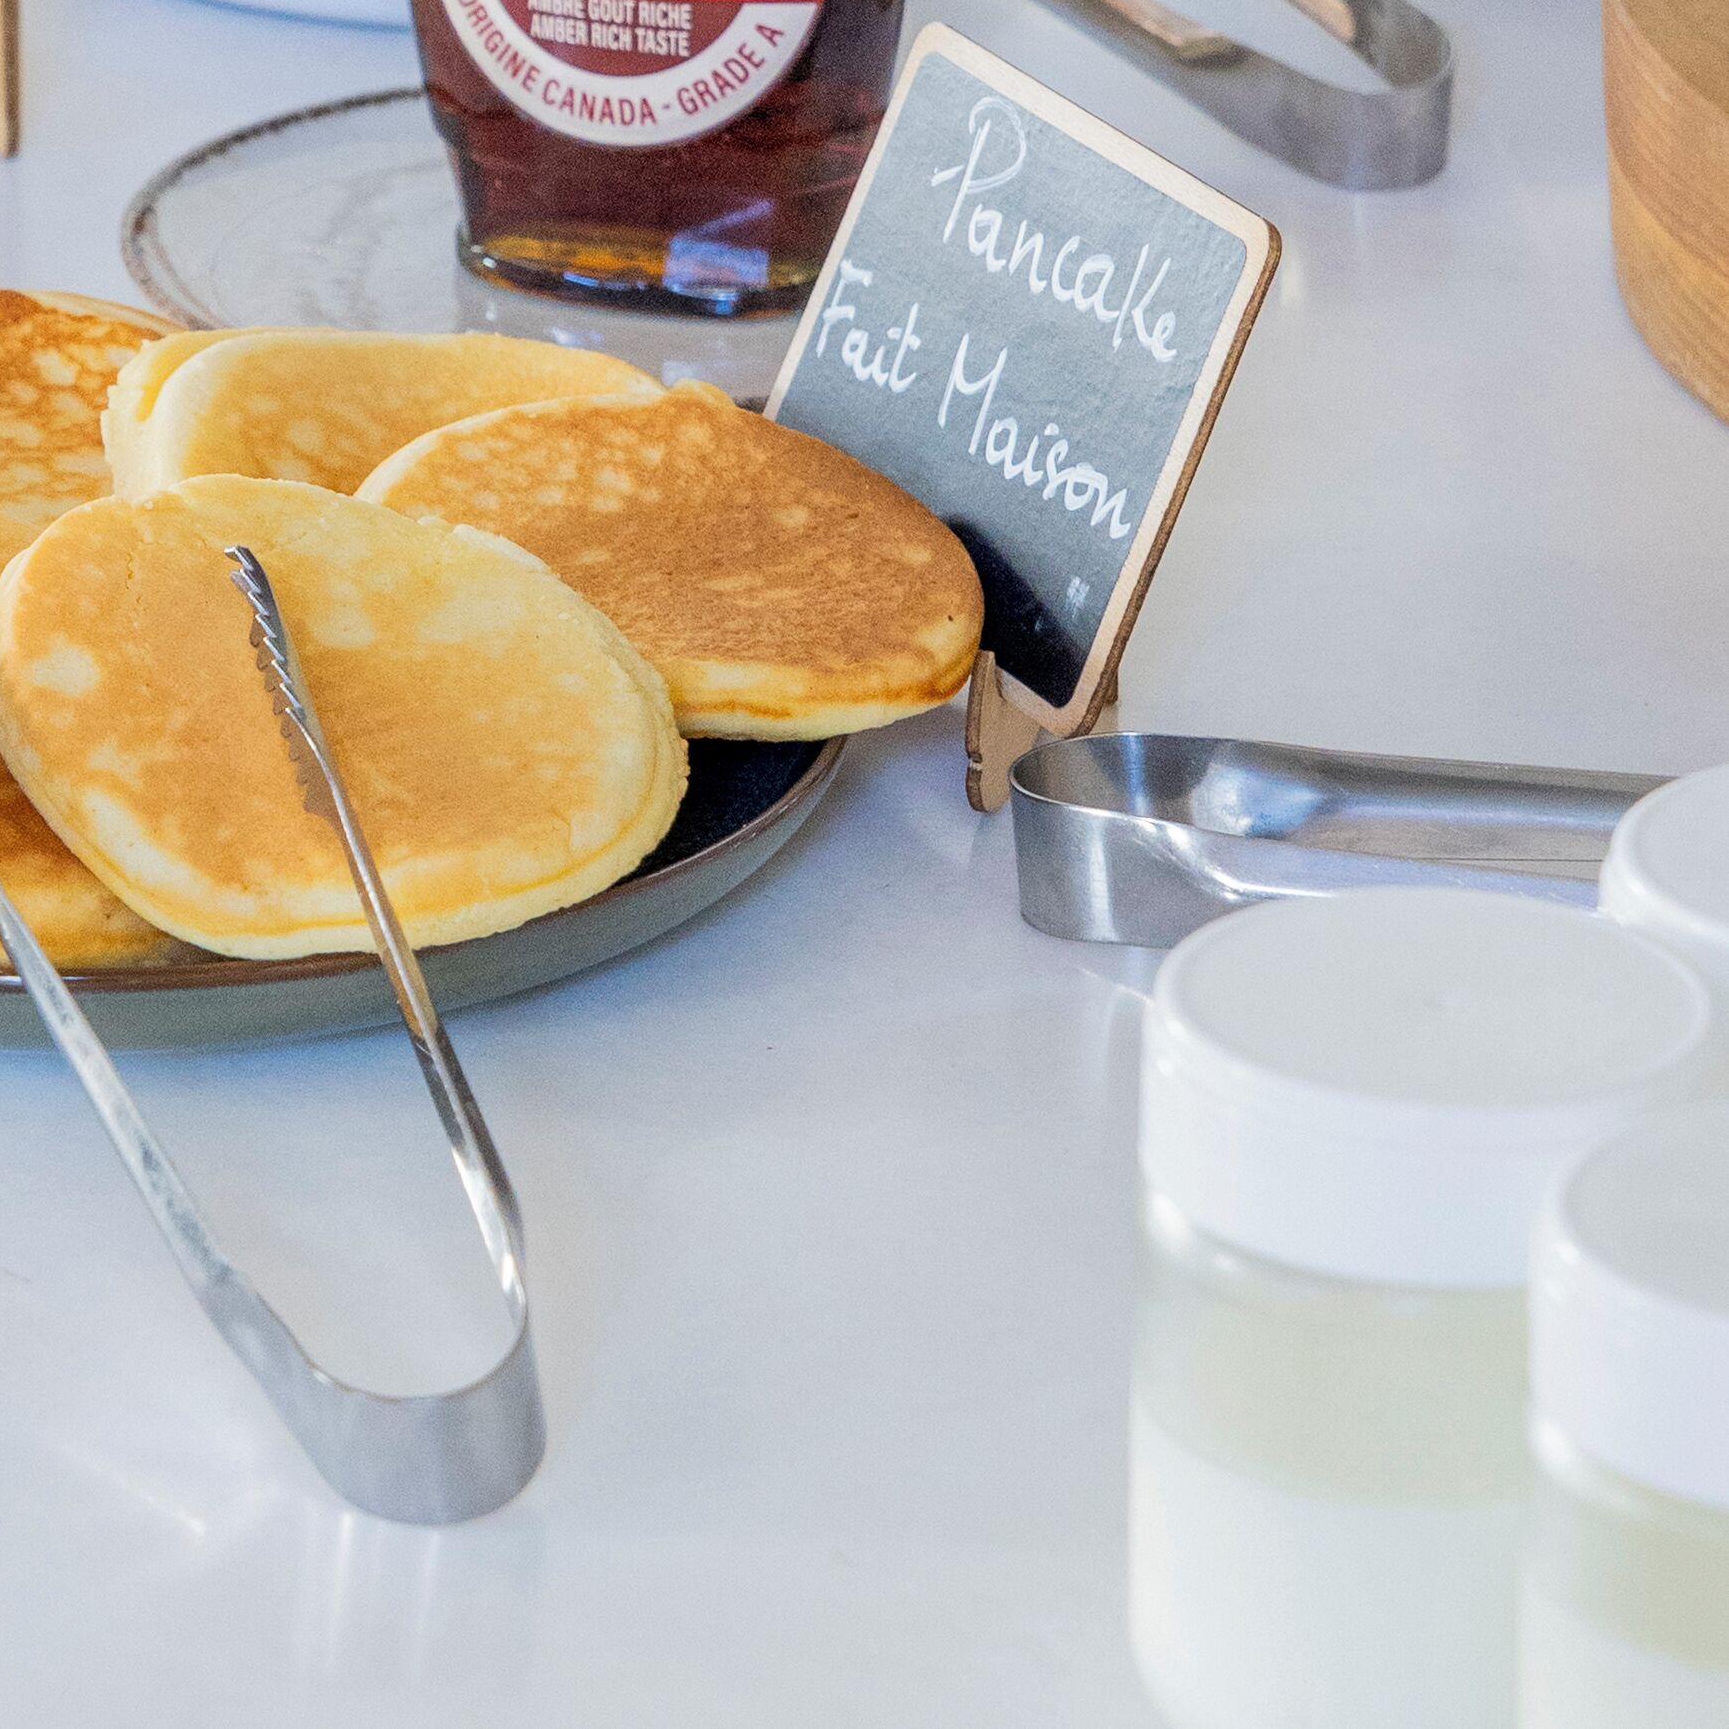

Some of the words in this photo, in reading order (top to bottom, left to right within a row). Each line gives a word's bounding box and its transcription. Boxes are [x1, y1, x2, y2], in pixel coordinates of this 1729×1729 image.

[530, 13, 589, 46] AMBER
[590, 23, 633, 50] RICH
[635, 27, 691, 57] TASTE
[638, 1, 692, 31] RICHE
[541, 78, 657, 128] CANADA
[675, 43, 766, 117] GRADE
[756, 21, 786, 48] A
[931, 95, 1178, 363] Pancake
[815, 257, 922, 394] Fait
[936, 332, 1132, 541] Maison
